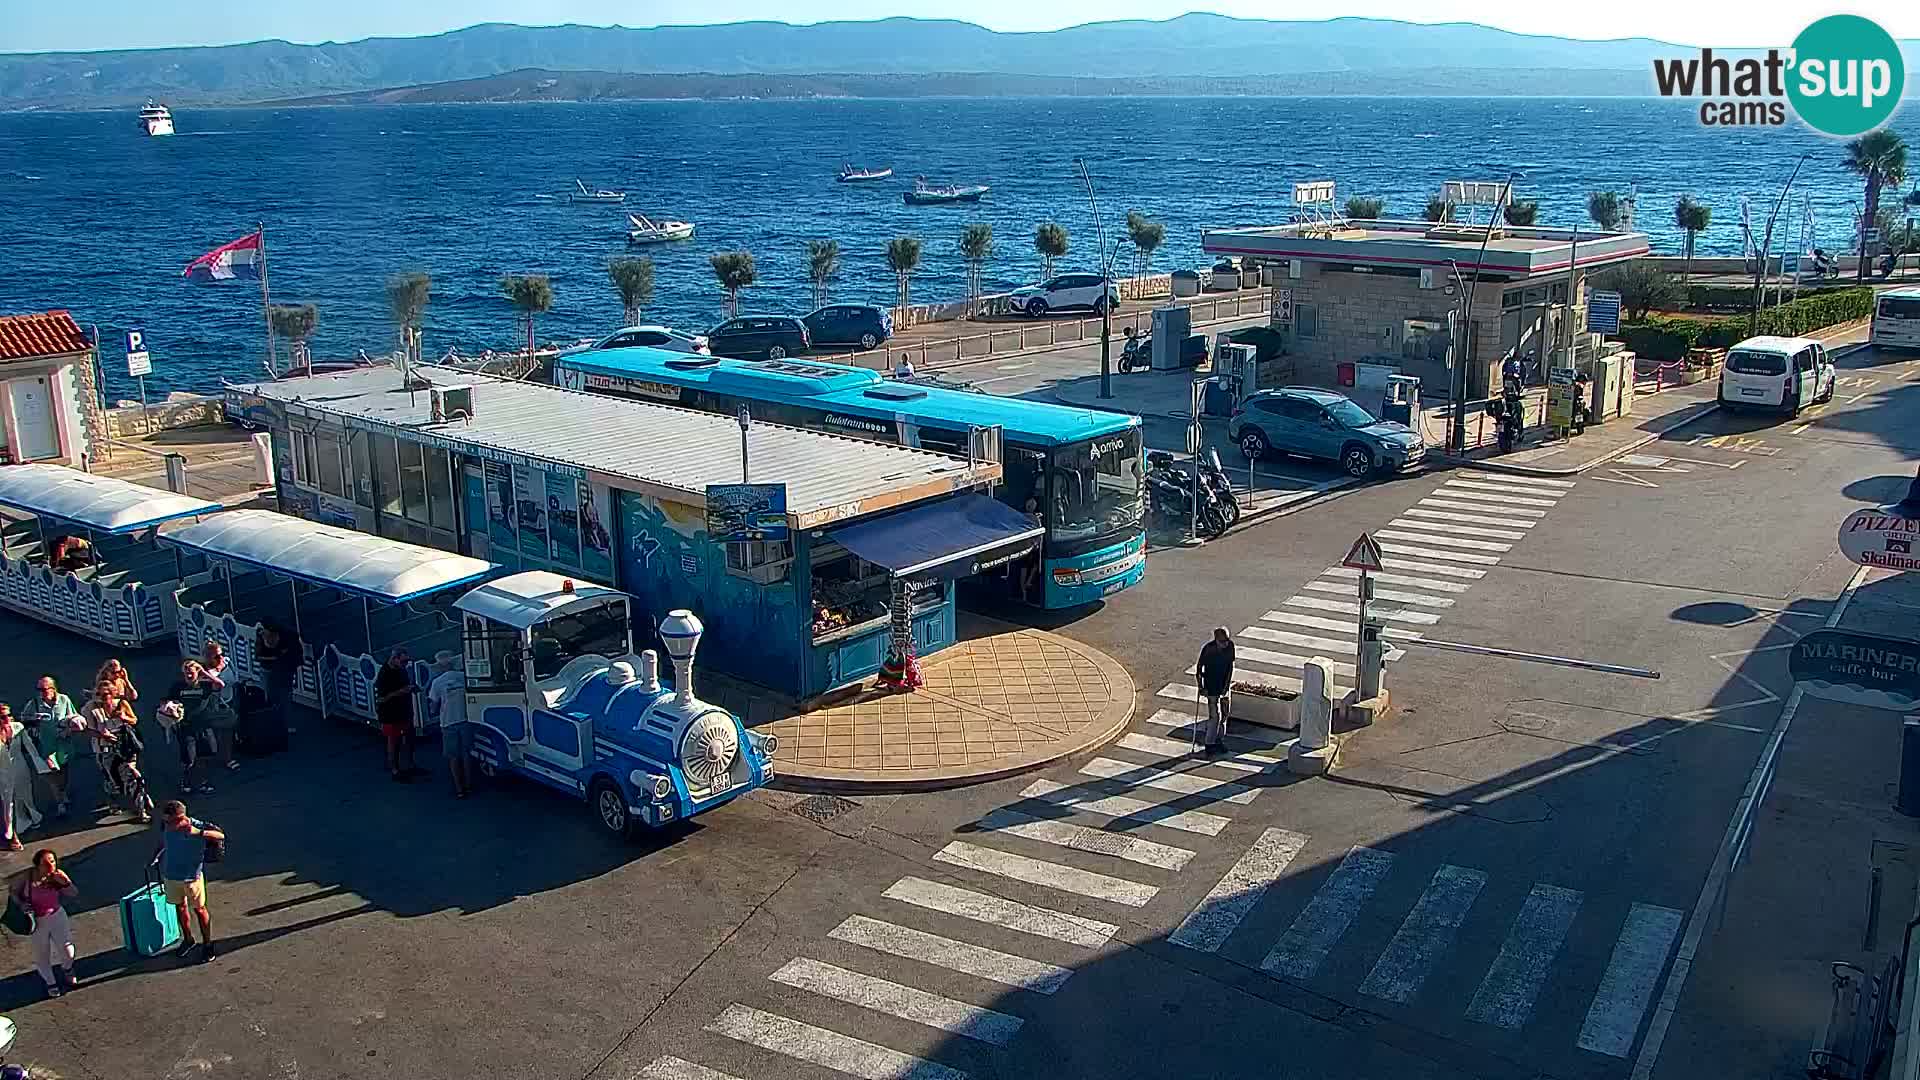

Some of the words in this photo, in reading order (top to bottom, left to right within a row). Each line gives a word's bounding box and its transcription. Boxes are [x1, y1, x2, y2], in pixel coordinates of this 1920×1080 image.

[131, 332, 142, 351] P
[1100, 439, 1124, 453] arriva
[479, 446, 493, 459] BUS
[494, 449, 526, 466] STATION
[527, 457, 554, 473] TICKET
[555, 463, 584, 478] OFFICE
[1849, 516, 1920, 533] PIZZE
[1871, 667, 1897, 681] bar
